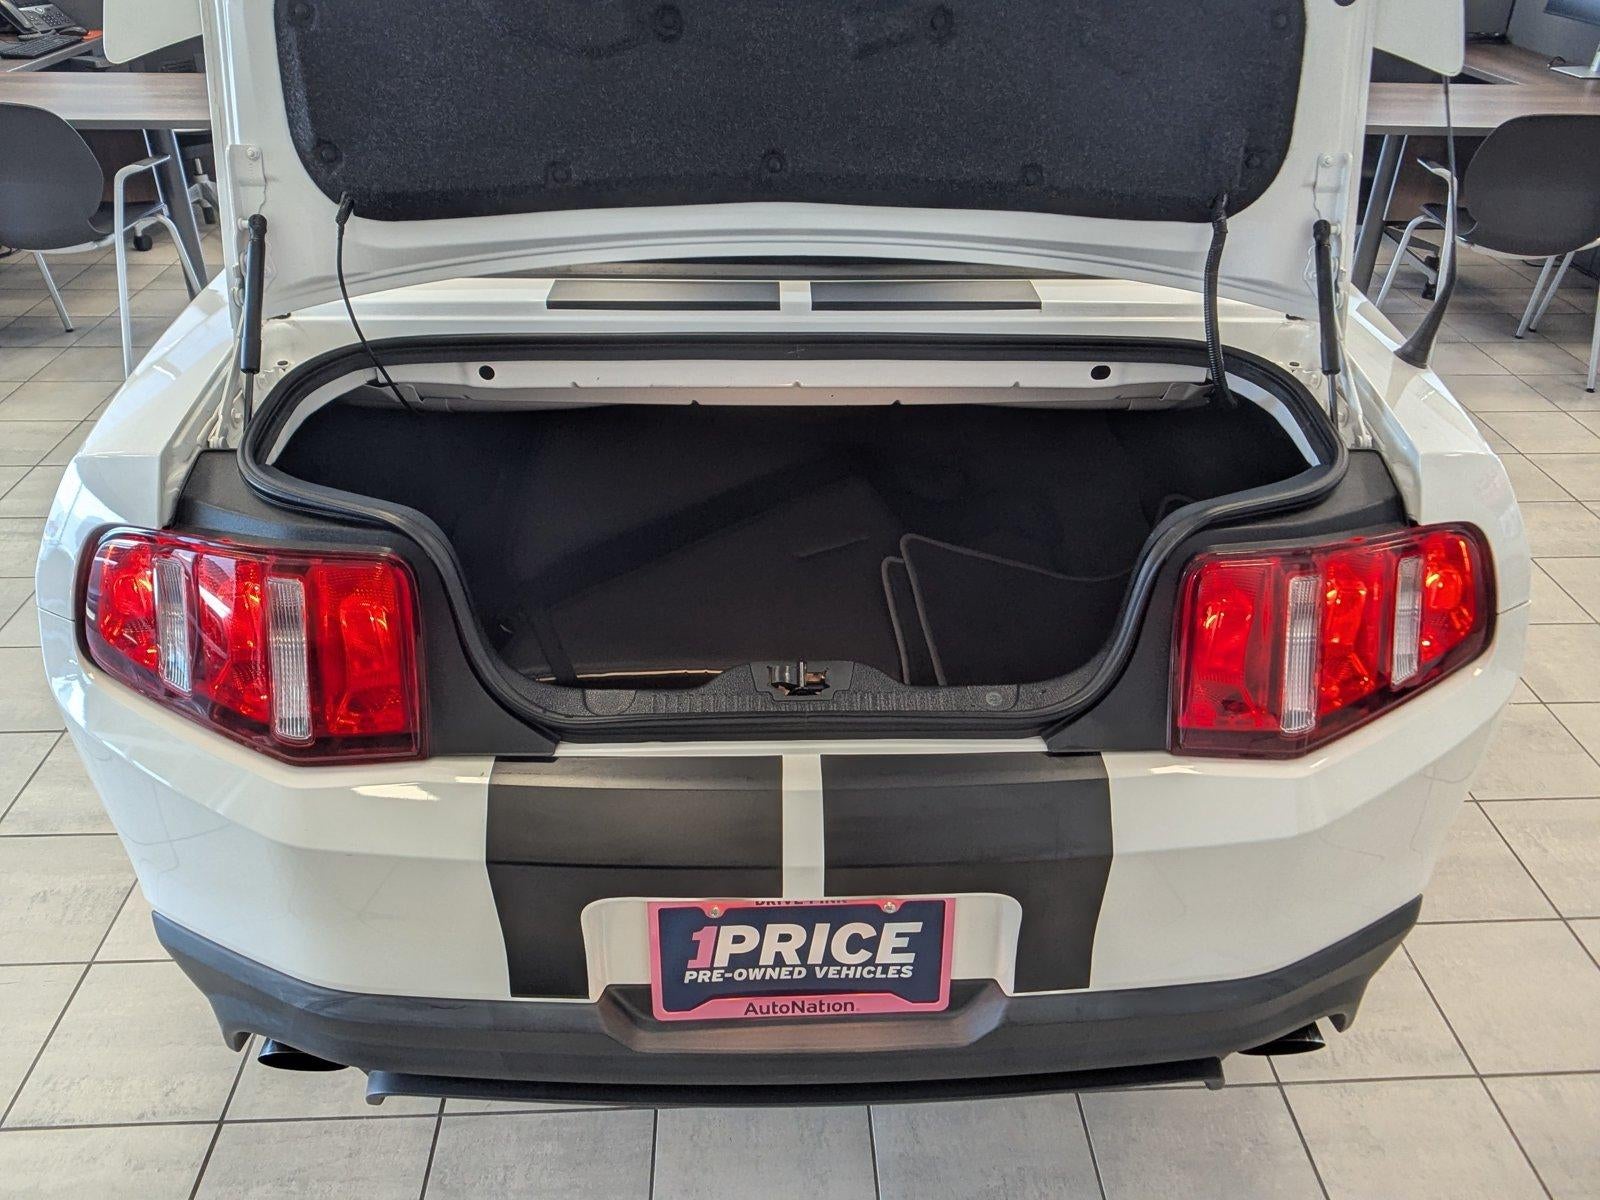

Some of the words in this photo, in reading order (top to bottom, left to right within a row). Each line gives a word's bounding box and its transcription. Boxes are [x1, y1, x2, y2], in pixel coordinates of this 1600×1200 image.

[683, 966, 807, 984] PRE-OWNED
[814, 965, 914, 979] VEHICLES
[743, 999, 855, 1016] AutoNation
